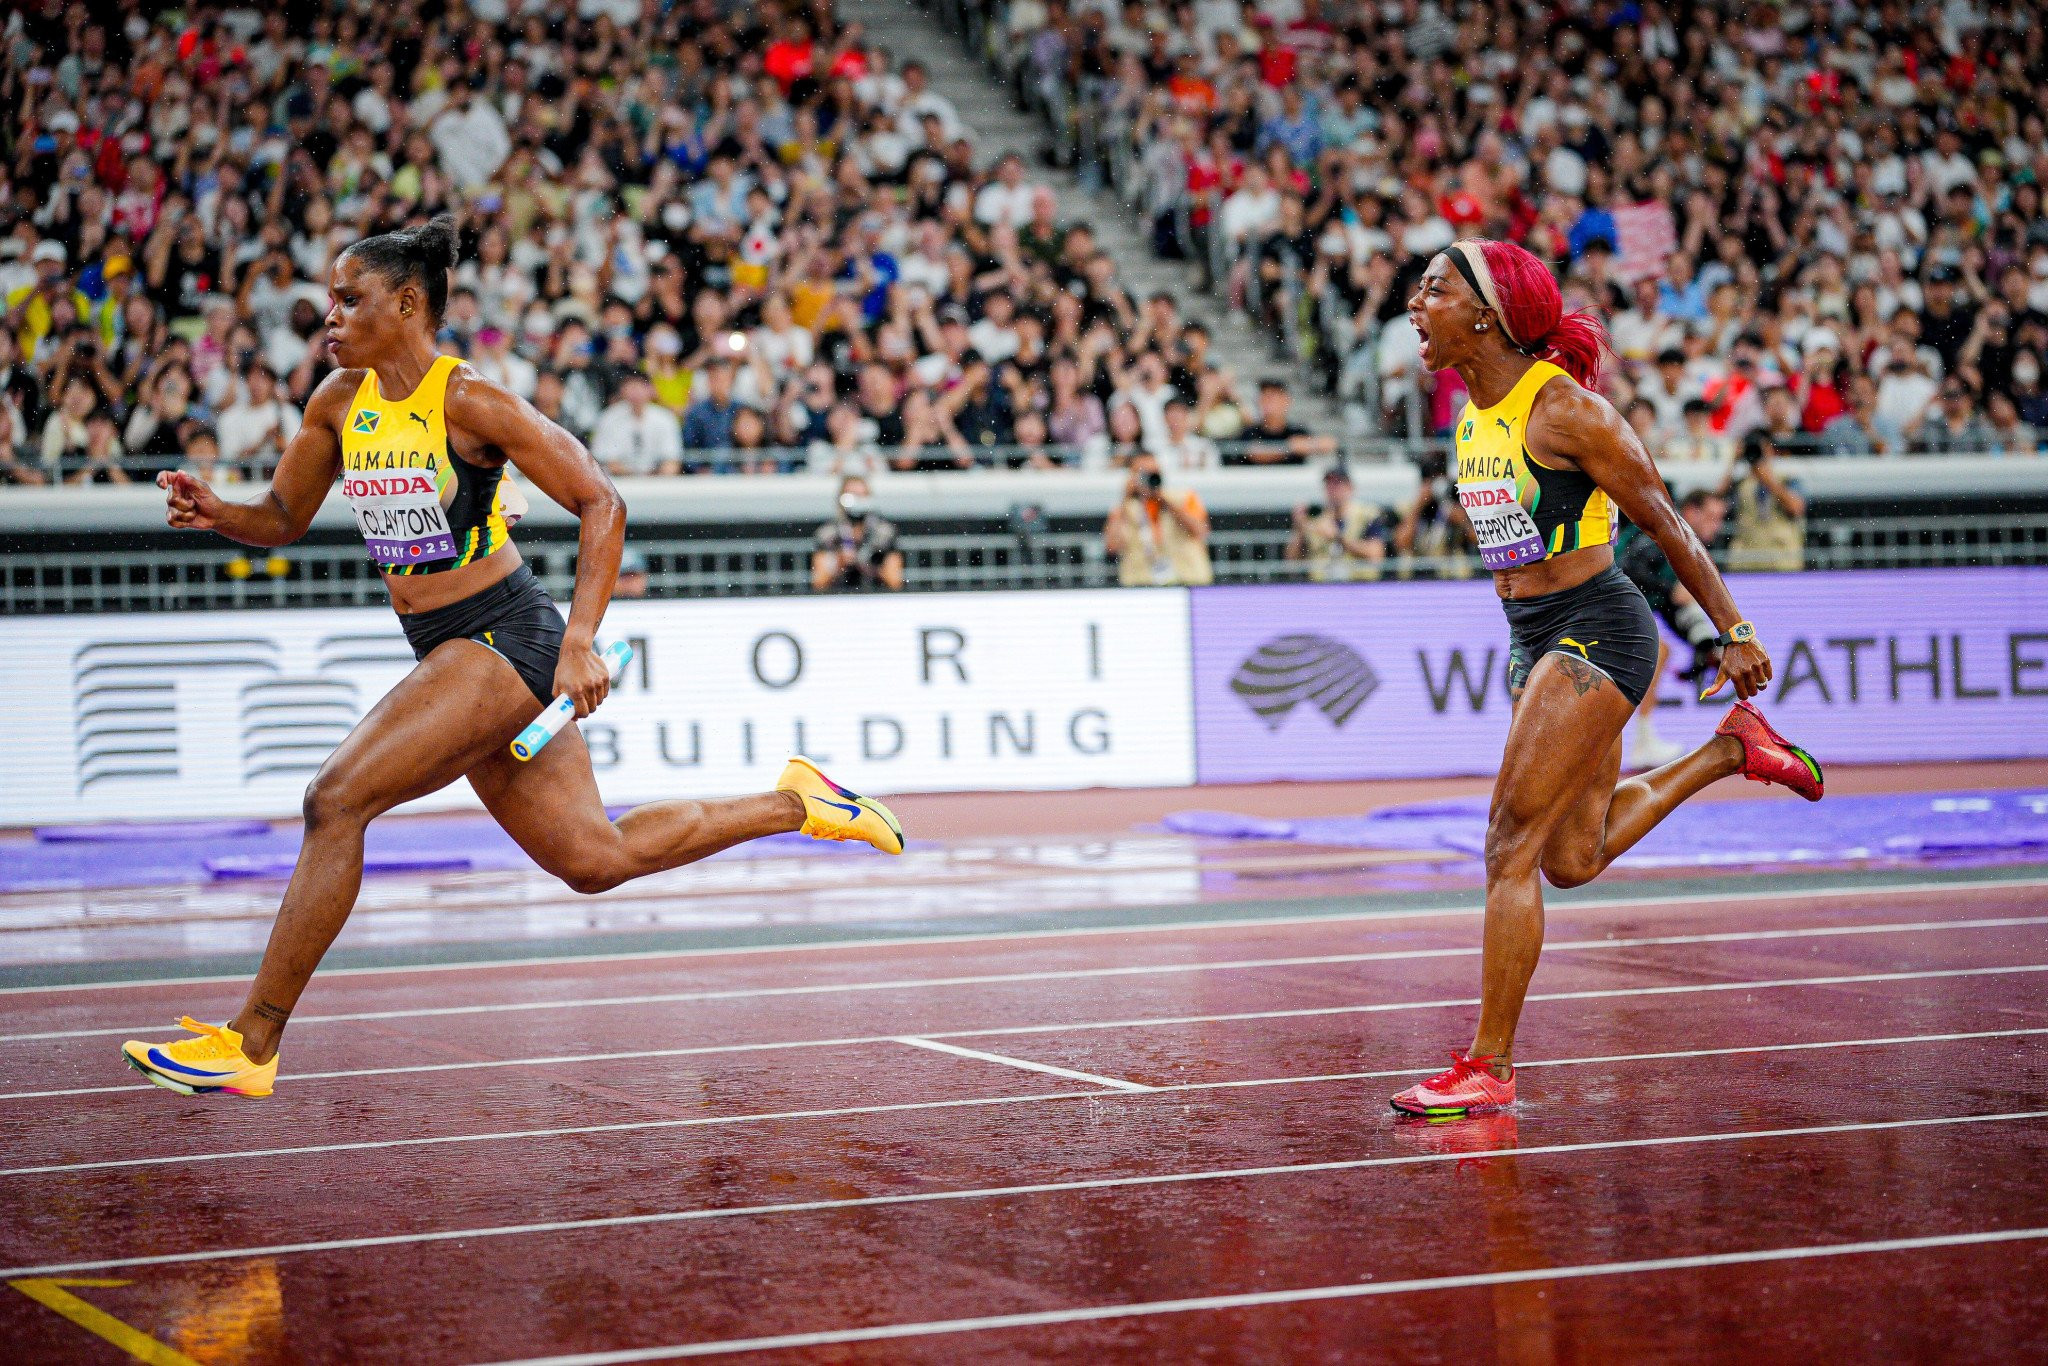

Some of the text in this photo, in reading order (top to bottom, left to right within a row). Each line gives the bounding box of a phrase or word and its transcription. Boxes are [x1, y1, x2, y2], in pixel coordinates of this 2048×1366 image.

[343, 477, 435, 496] HONDA
[363, 506, 442, 537] CLAYTON
[584, 708, 1111, 768] BUILDING
